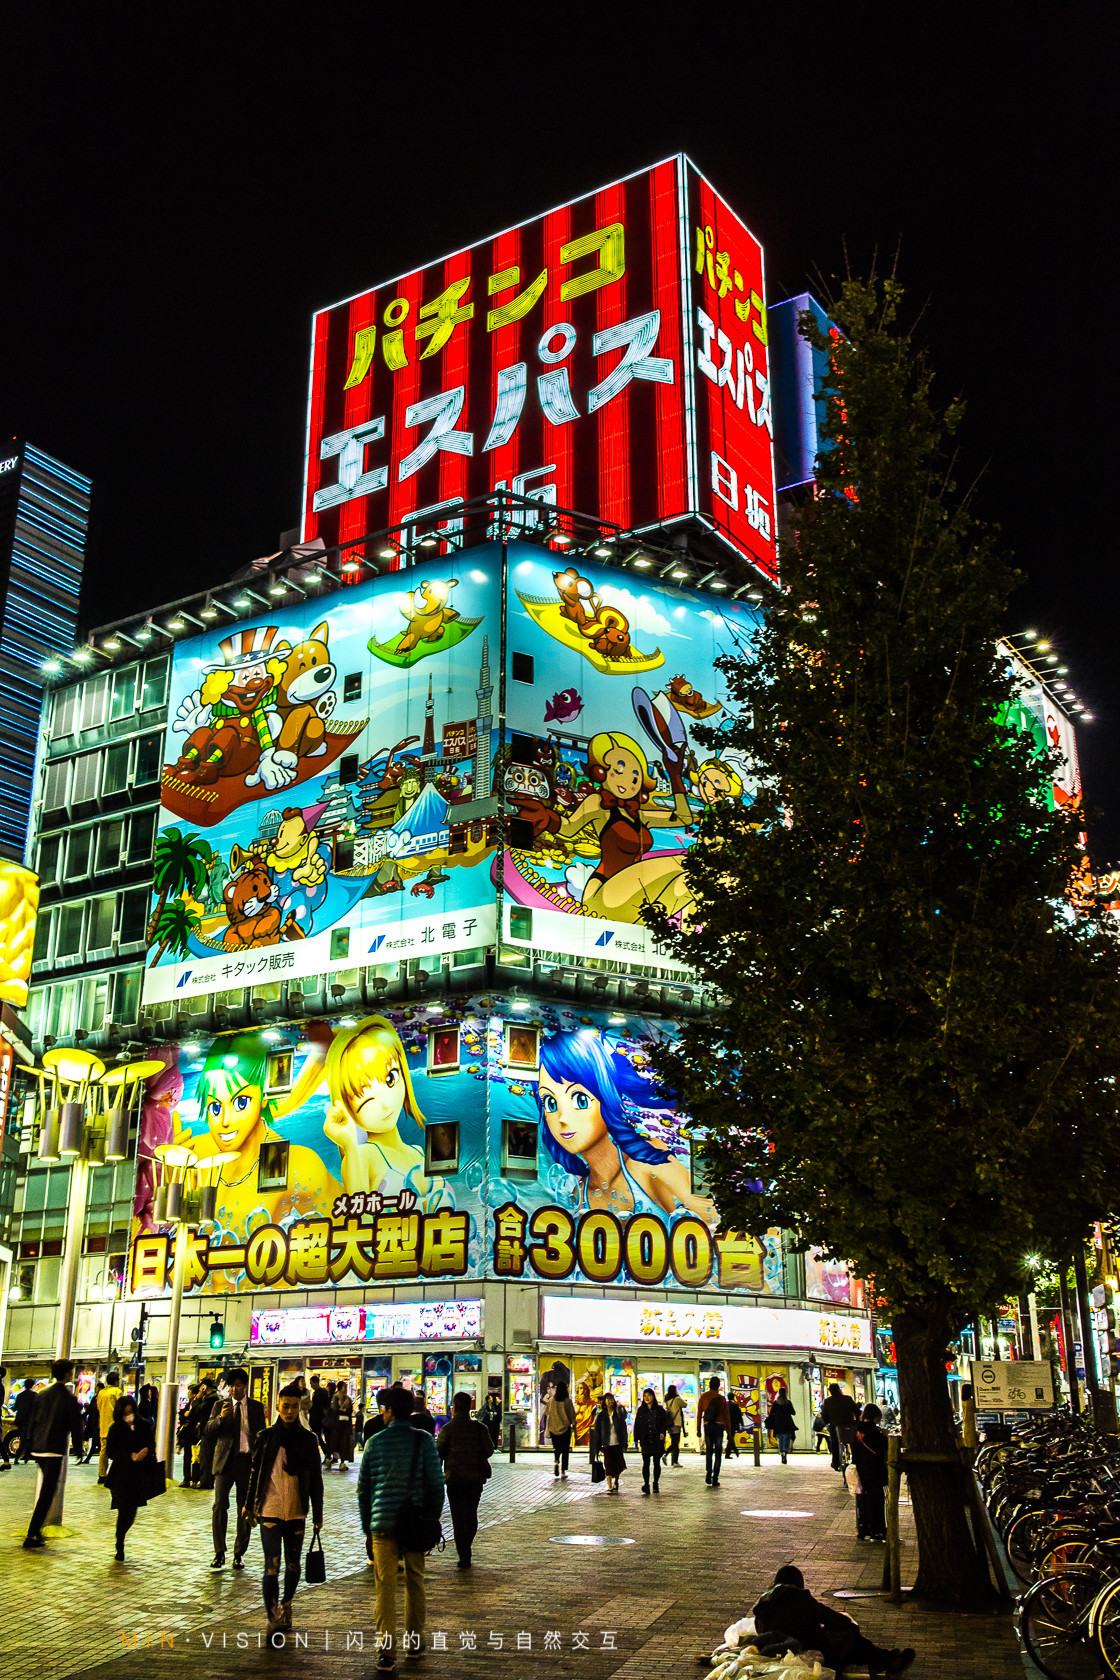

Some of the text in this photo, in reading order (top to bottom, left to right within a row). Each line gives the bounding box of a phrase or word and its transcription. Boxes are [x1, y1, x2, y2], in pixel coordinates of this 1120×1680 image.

[343, 222, 626, 391] パチンコ
[695, 225, 769, 347] パチンコ
[313, 309, 675, 513] エスパス
[696, 306, 774, 441] エスパス
[711, 450, 771, 542] 日拓
[191, 951, 296, 985] 株式会社 キタック販売
[384, 918, 478, 950] 株式会社 北電子
[614, 939, 646, 953] 株式会社
[333, 1192, 416, 1217] メガホール
[496, 1205, 526, 1272] 合計
[131, 1209, 470, 1294] 日本一の超大型店
[640, 1308, 725, 1339] 新台入替
